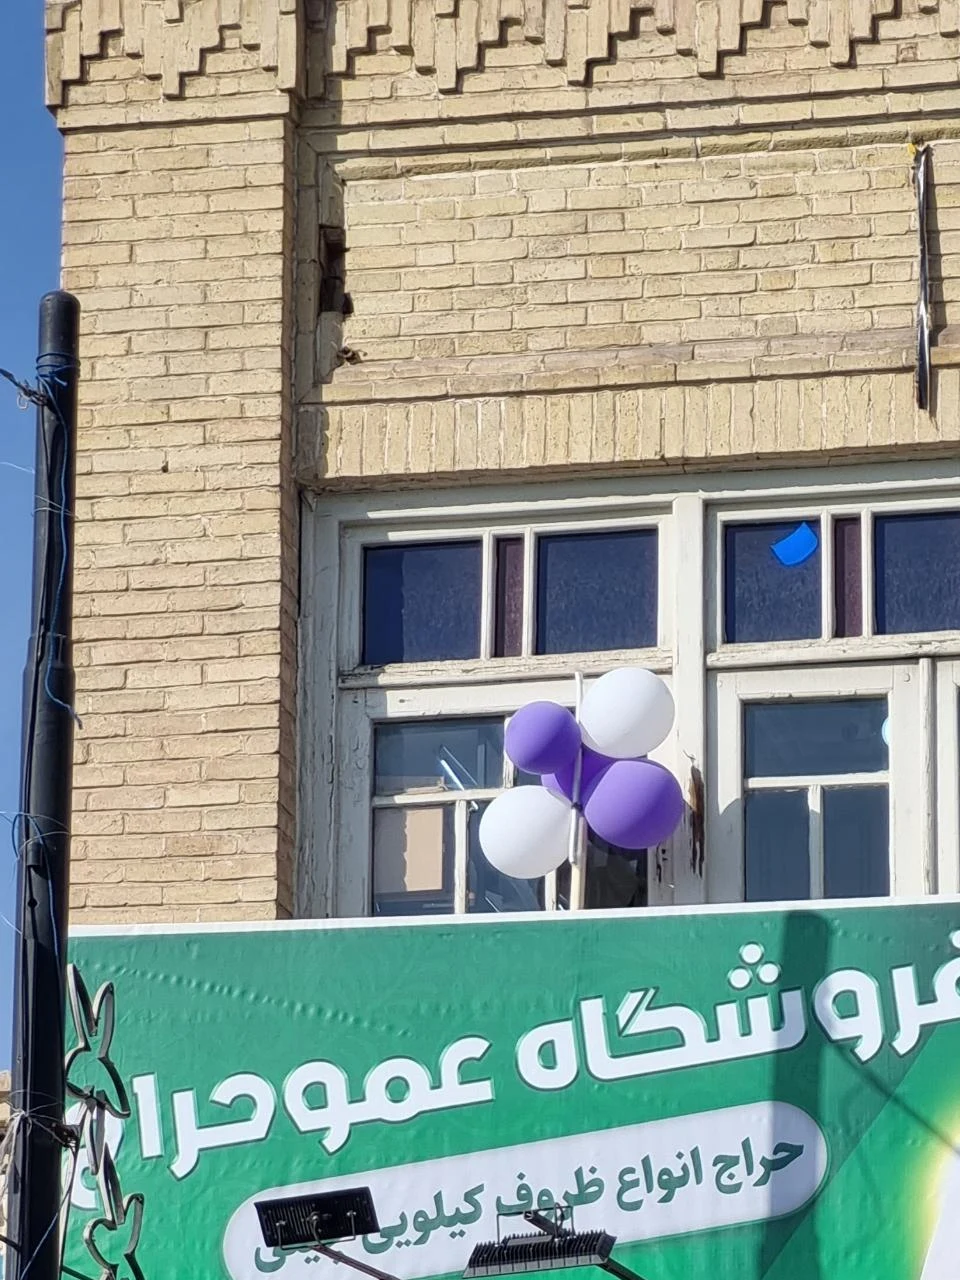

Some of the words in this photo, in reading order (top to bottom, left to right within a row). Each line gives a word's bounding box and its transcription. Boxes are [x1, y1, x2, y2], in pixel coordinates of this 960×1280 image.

[496, 1164, 606, 1220] ظروف
[616, 1145, 703, 1213] انواع
[711, 1136, 805, 1195] حراج
[362, 1183, 485, 1255] کیلویی
